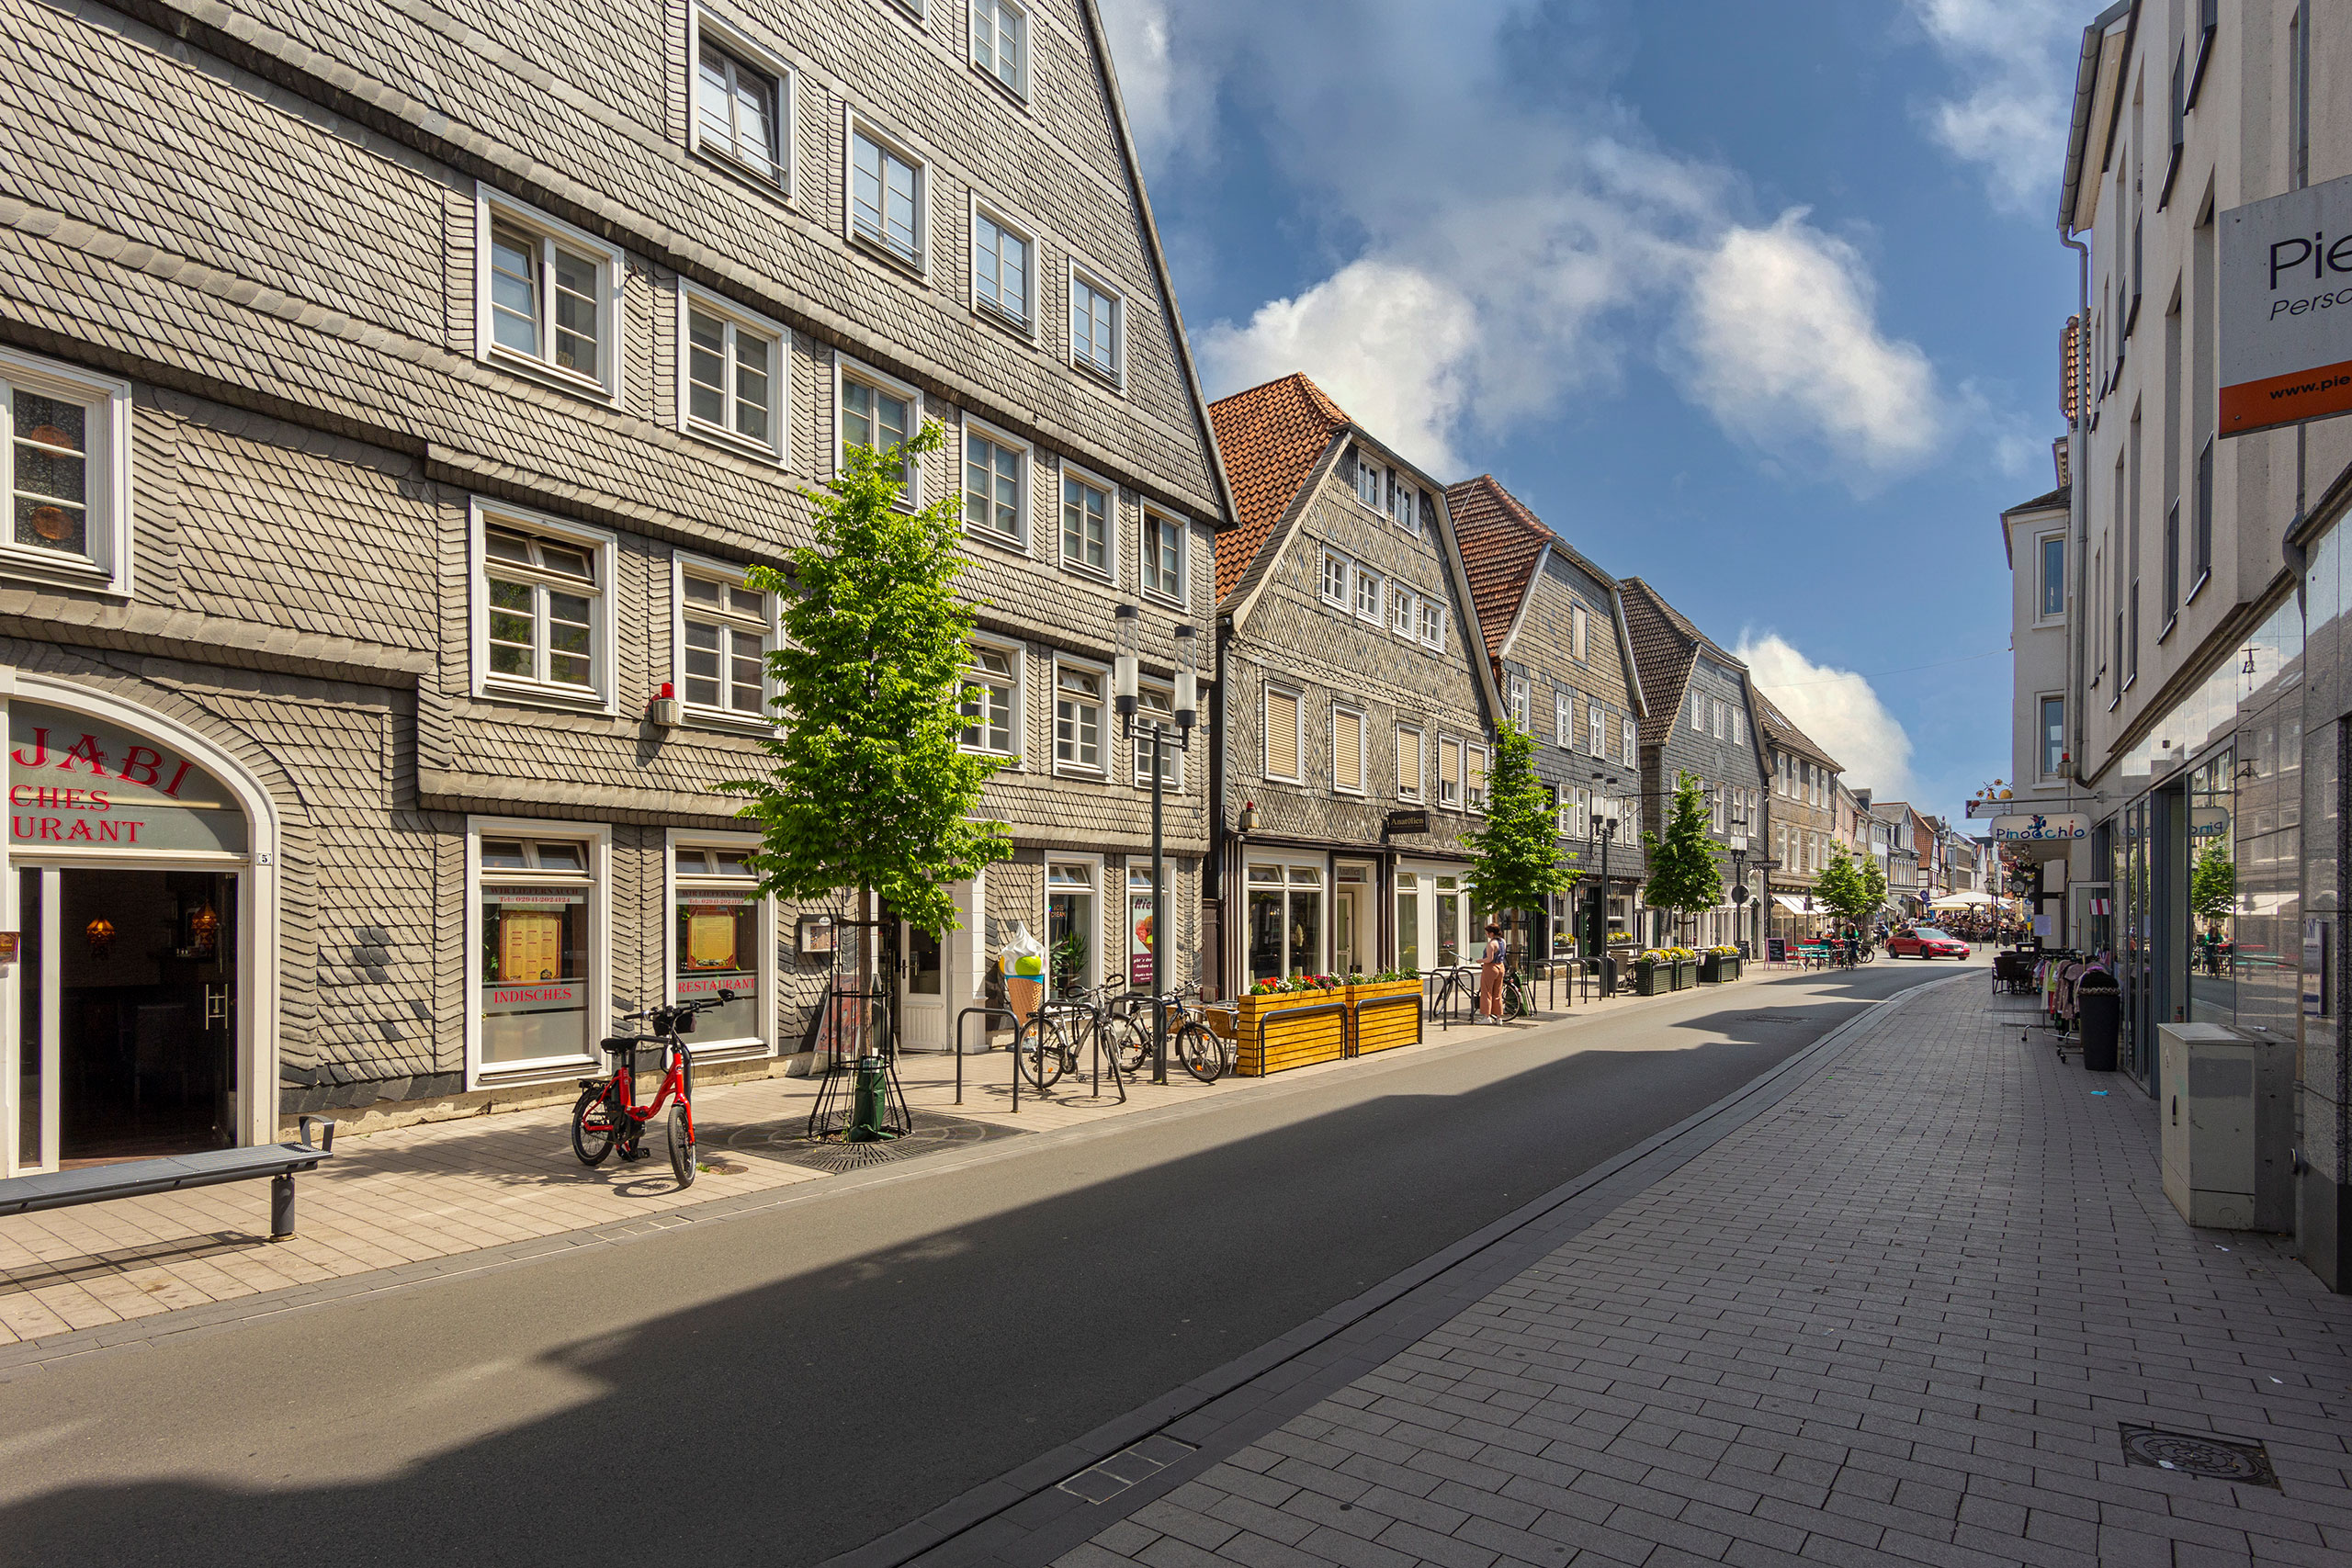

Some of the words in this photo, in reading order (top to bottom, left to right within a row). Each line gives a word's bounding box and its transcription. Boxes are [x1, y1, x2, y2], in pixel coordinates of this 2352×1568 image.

[2270, 231, 2352, 290] Pie
[2270, 288, 2352, 321] Perso
[2269, 375, 2351, 400] www.pie
[10, 727, 195, 800] JABI
[9, 784, 112, 812] CHES
[12, 816, 146, 843] URANT
[1996, 819, 2085, 840] Pinocchio
[261, 854, 268, 863] 5
[1134, 898, 1153, 910] Hie
[494, 987, 572, 1004] INDISCHES
[678, 978, 755, 993] RESTAURANT
